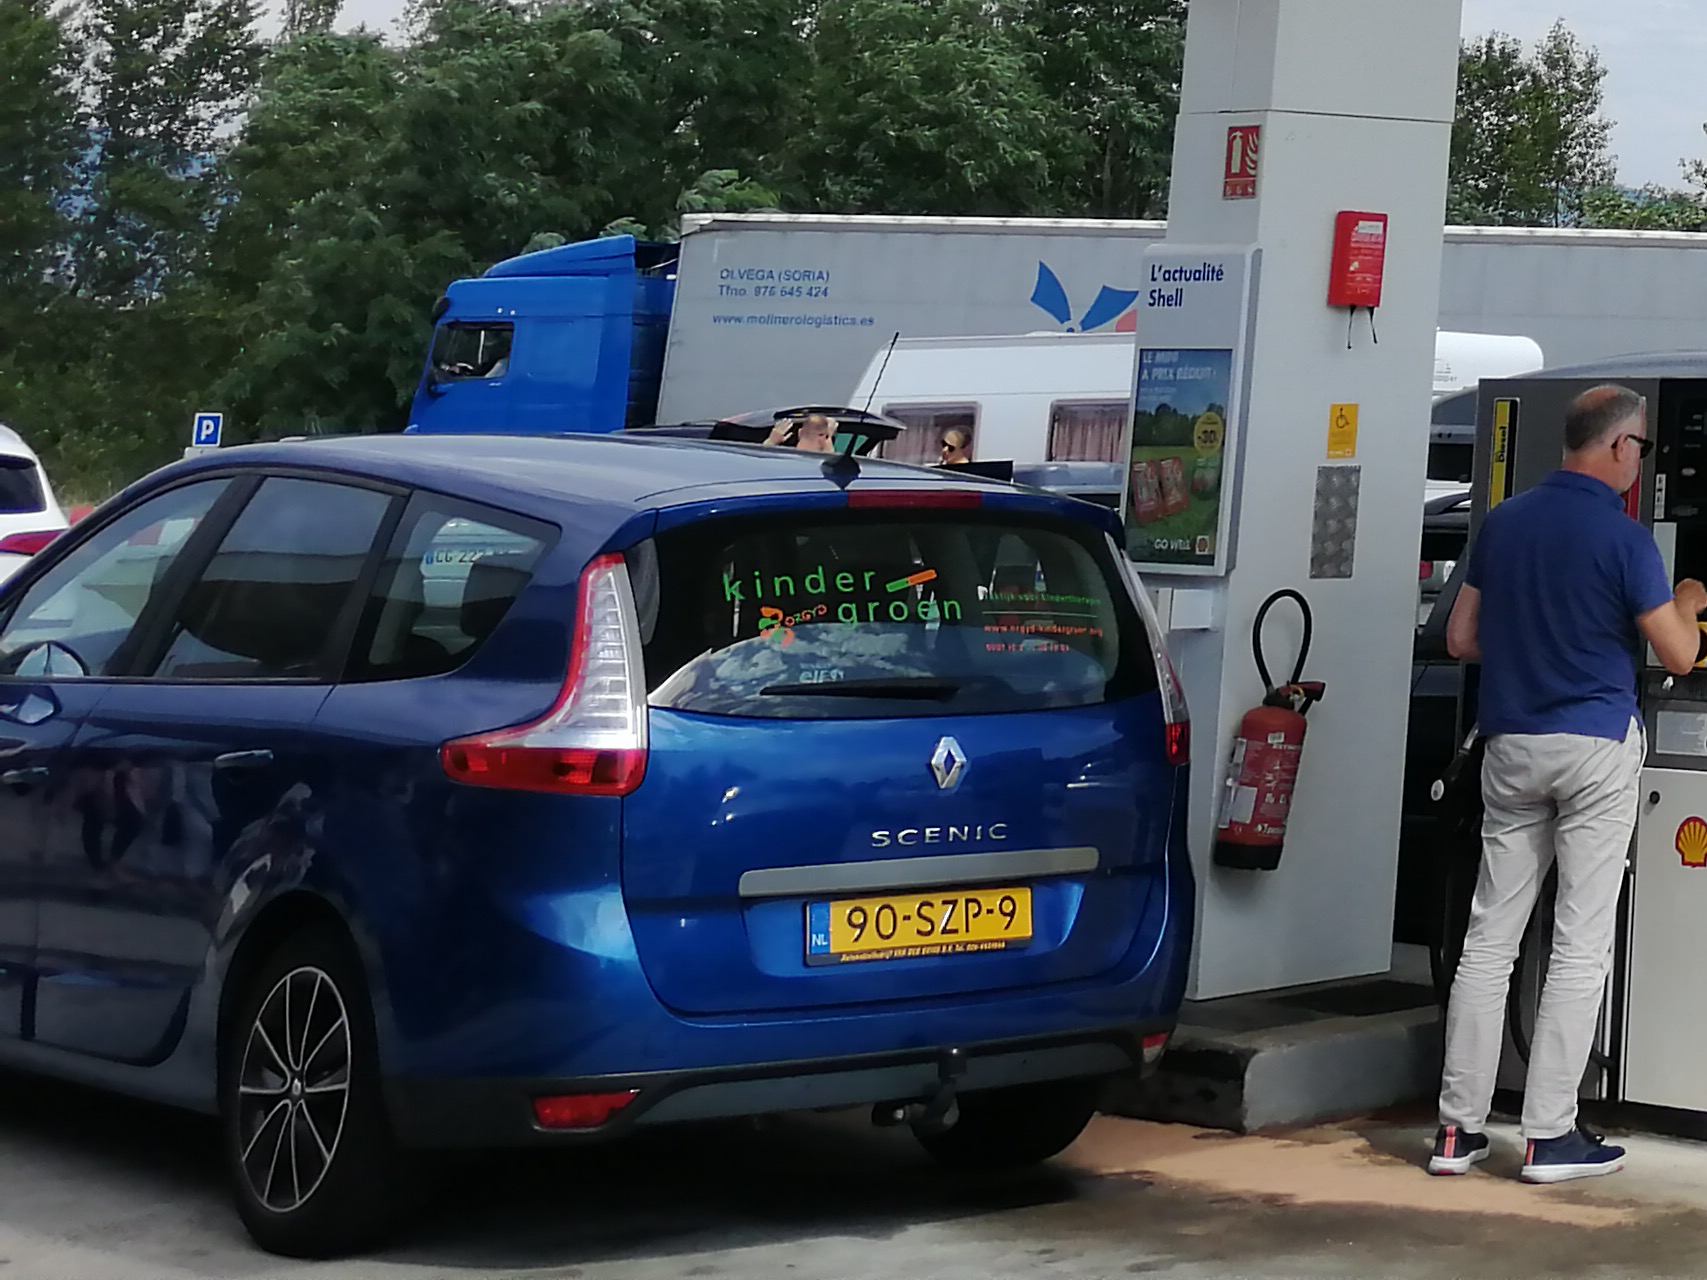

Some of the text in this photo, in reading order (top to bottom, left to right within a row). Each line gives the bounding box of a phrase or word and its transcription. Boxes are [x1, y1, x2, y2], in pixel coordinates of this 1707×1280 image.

[778, 269, 830, 283] (SORIA)
[1150, 261, 1225, 282] L'actualité
[1148, 288, 1184, 308] Shell
[200, 419, 215, 441] P
[1496, 426, 1508, 464] Diesel
[722, 565, 877, 602] kinder
[837, 598, 963, 630] groen
[871, 822, 1009, 848] SCENIC
[846, 894, 1017, 943] 90-SZP-9
[812, 933, 829, 947] NL
